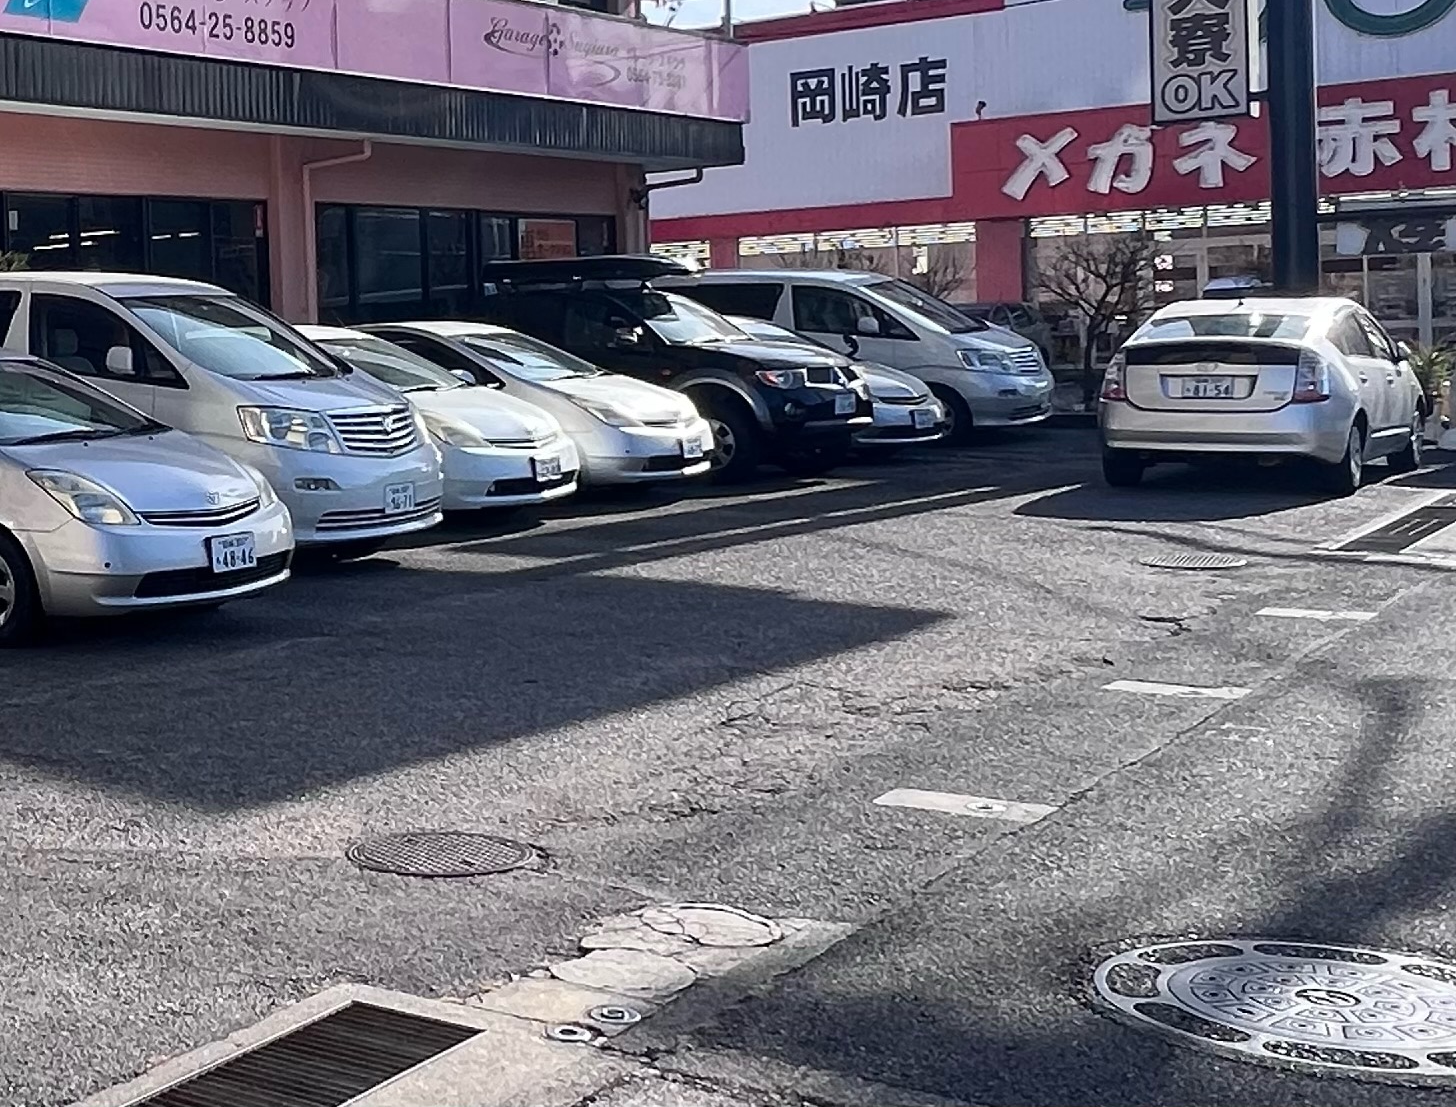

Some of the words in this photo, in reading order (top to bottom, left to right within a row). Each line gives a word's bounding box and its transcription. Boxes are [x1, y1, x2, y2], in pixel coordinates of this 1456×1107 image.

[140, 1, 296, 48] 0564-25-8859
[790, 57, 947, 127] 岡崎店
